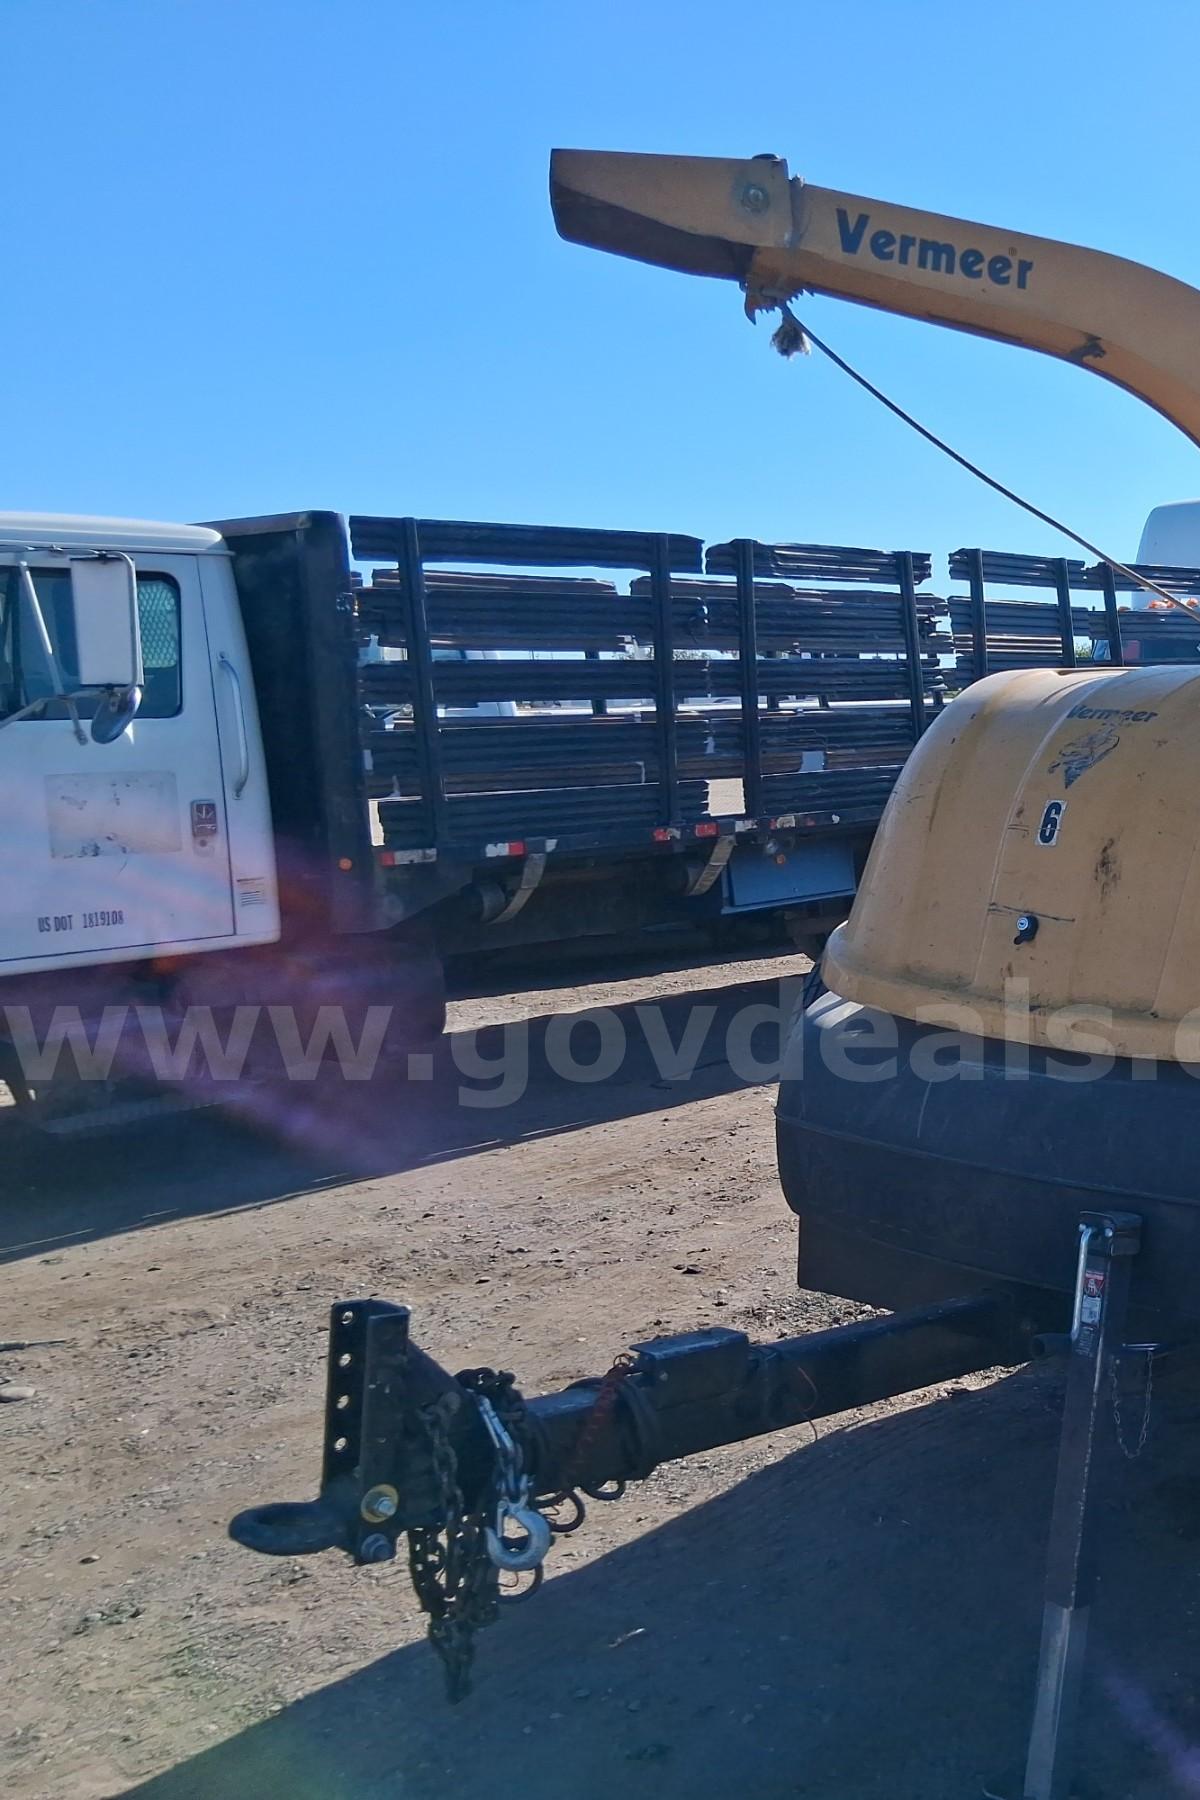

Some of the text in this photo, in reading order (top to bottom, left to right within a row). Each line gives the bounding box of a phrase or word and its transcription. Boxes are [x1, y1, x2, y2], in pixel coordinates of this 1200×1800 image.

[836, 207, 1034, 290] Vermeer
[1039, 801, 1062, 843] 6
[38, 910, 124, 932] US DOT 1819108
